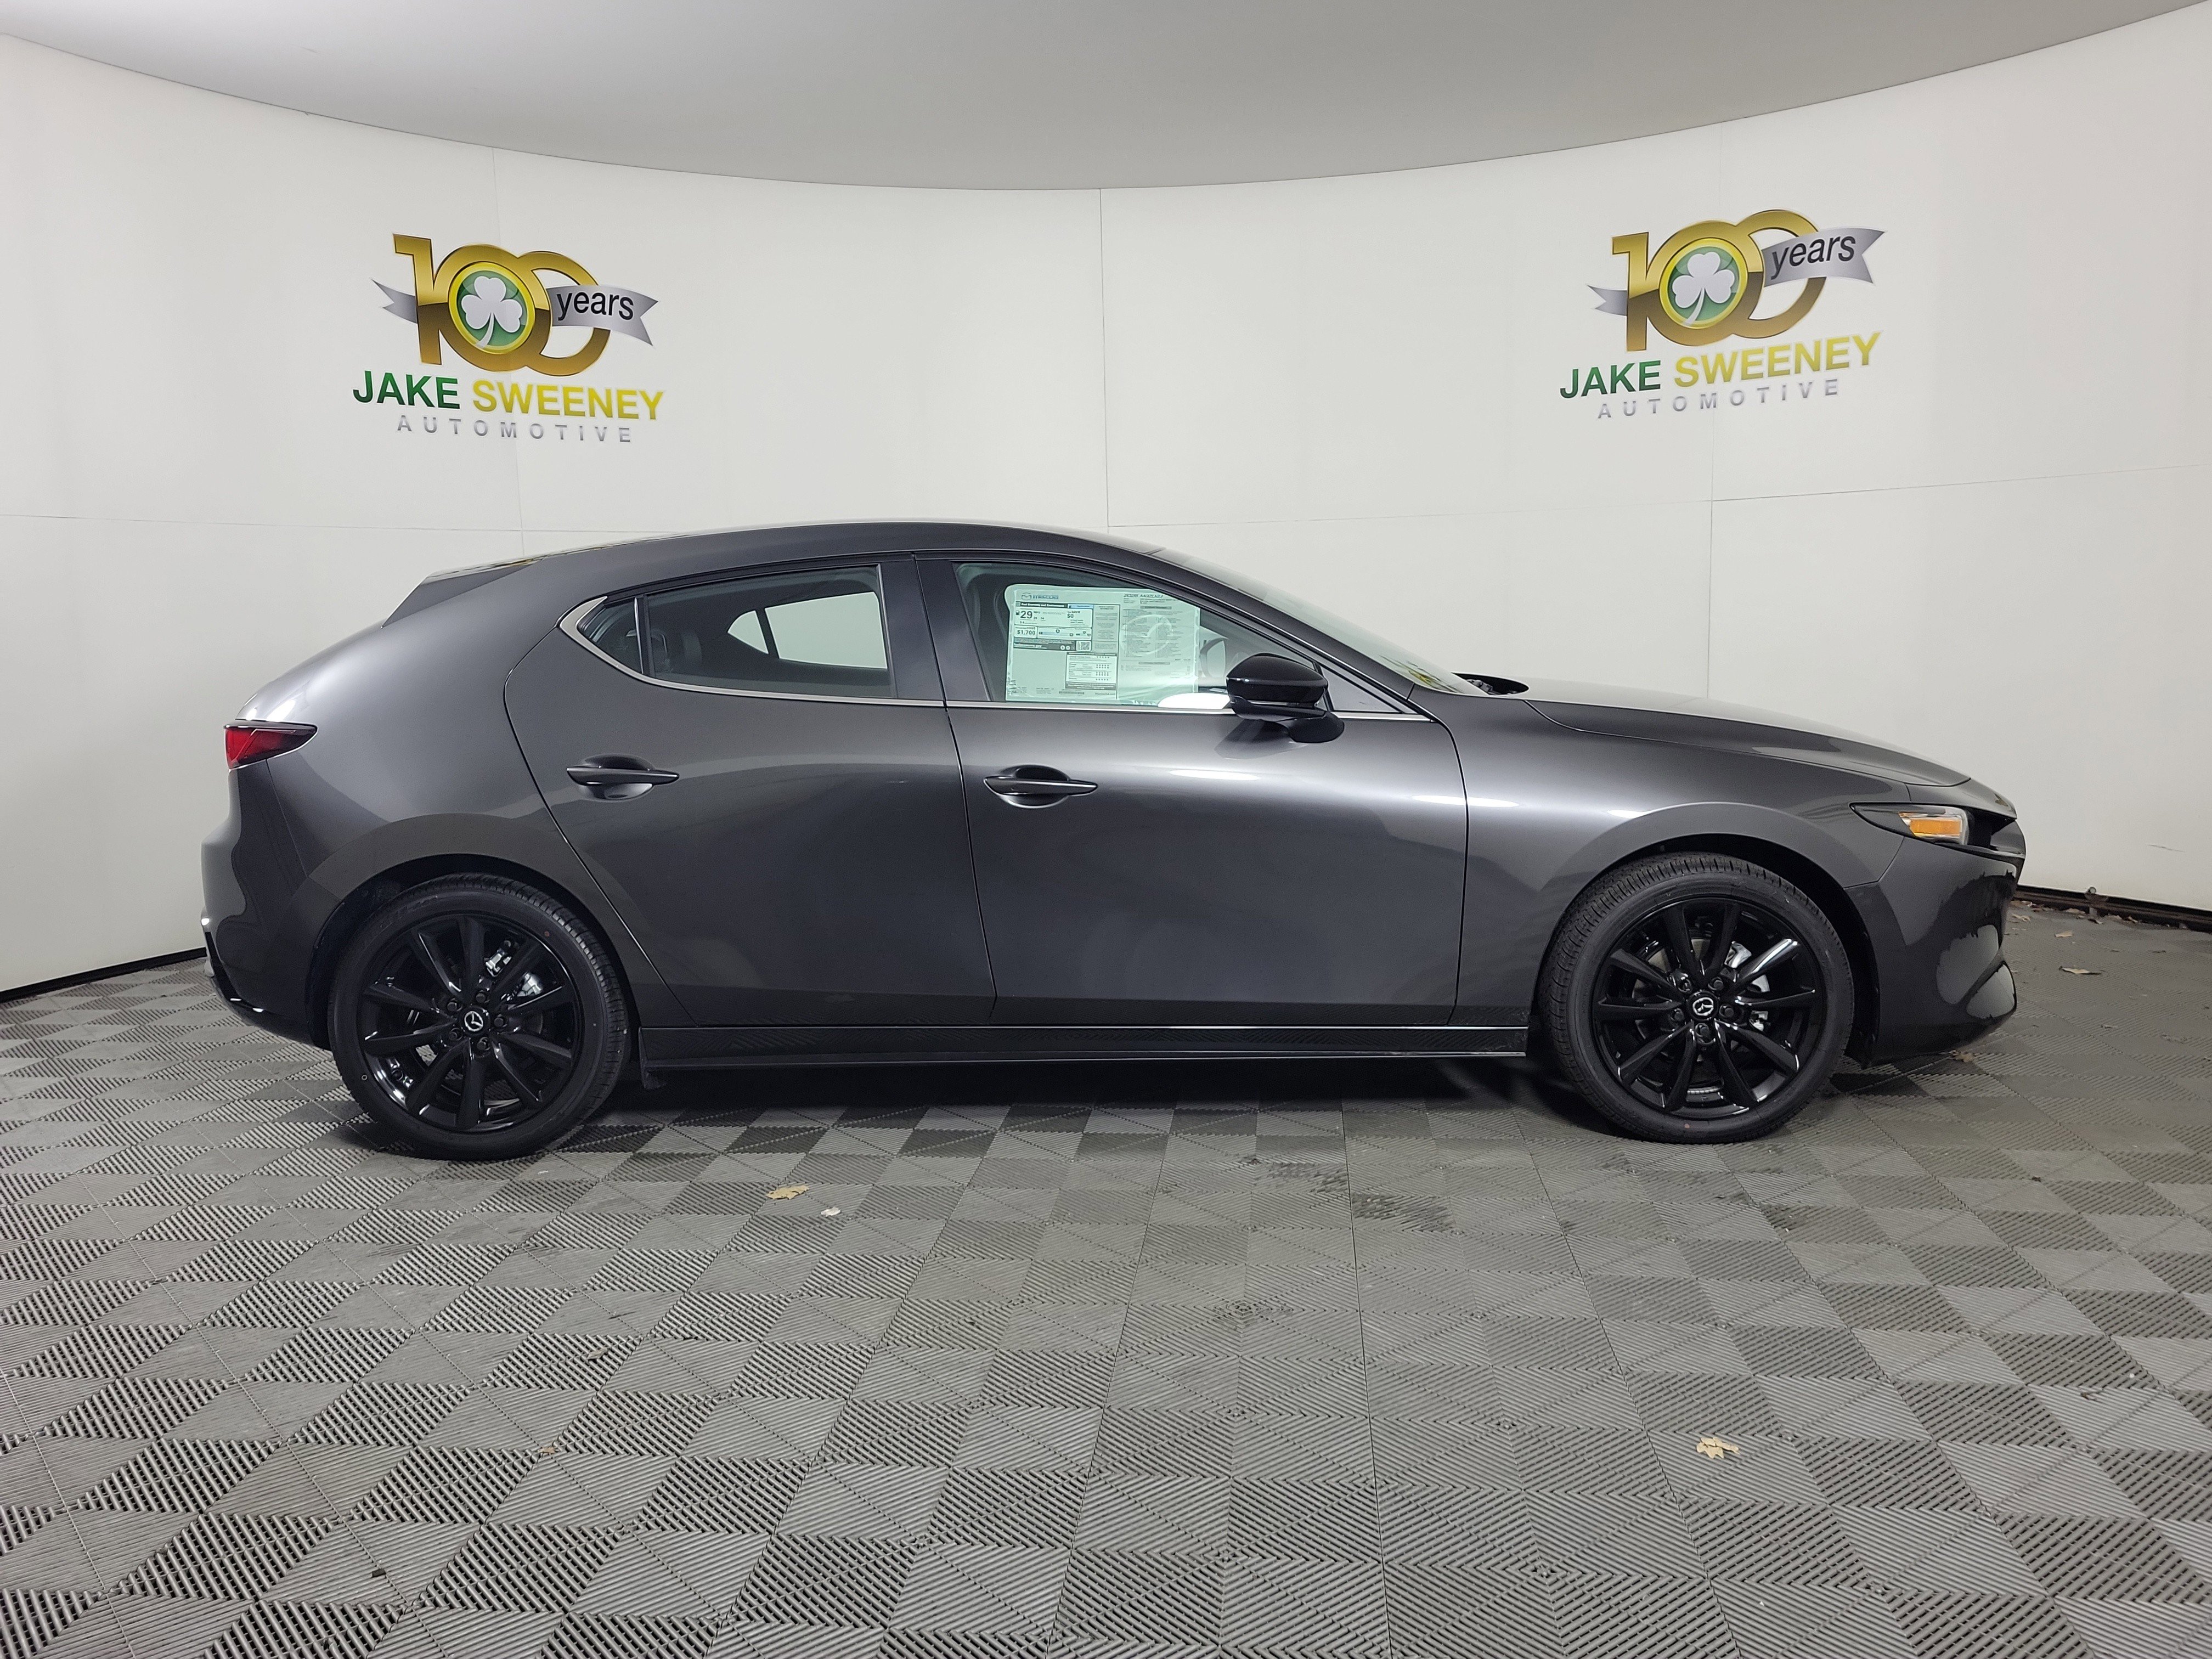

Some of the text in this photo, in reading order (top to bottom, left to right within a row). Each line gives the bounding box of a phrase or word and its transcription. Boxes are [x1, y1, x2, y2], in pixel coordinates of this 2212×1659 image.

[1612, 208, 1827, 352] 100
[1770, 235, 1857, 280] years
[392, 233, 611, 377] 100
[556, 291, 635, 321] years
[1560, 331, 1882, 399] JAKE SWEENEY
[352, 370, 664, 421] JAKE SWEENEY
[1597, 379, 1839, 419] AUTOMOTIVE
[397, 415, 632, 443] AUTOMOTIVE
[1020, 611, 1032, 619] 29
